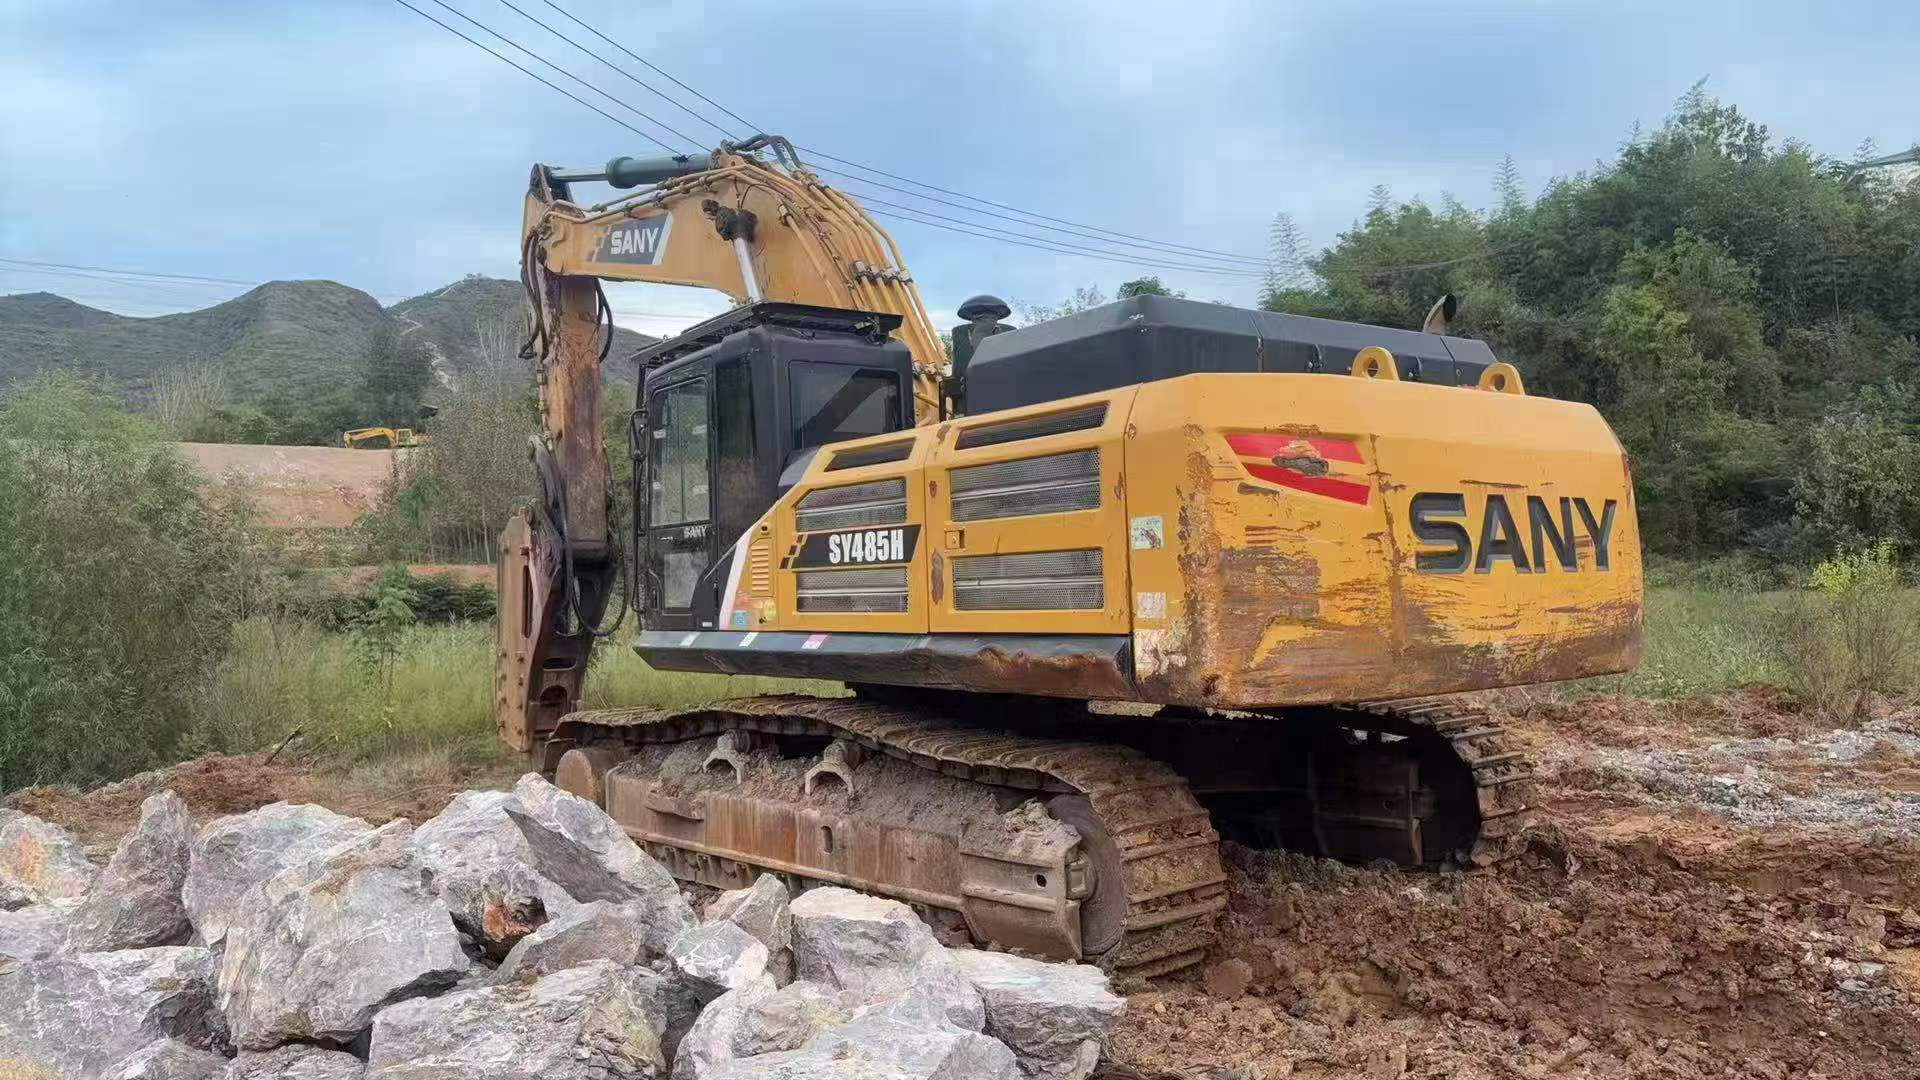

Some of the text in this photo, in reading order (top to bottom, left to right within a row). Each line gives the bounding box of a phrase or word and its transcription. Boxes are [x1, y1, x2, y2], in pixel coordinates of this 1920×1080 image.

[611, 227, 659, 255] SANY
[828, 528, 904, 564] SY485H
[1409, 491, 1618, 575] SANY
